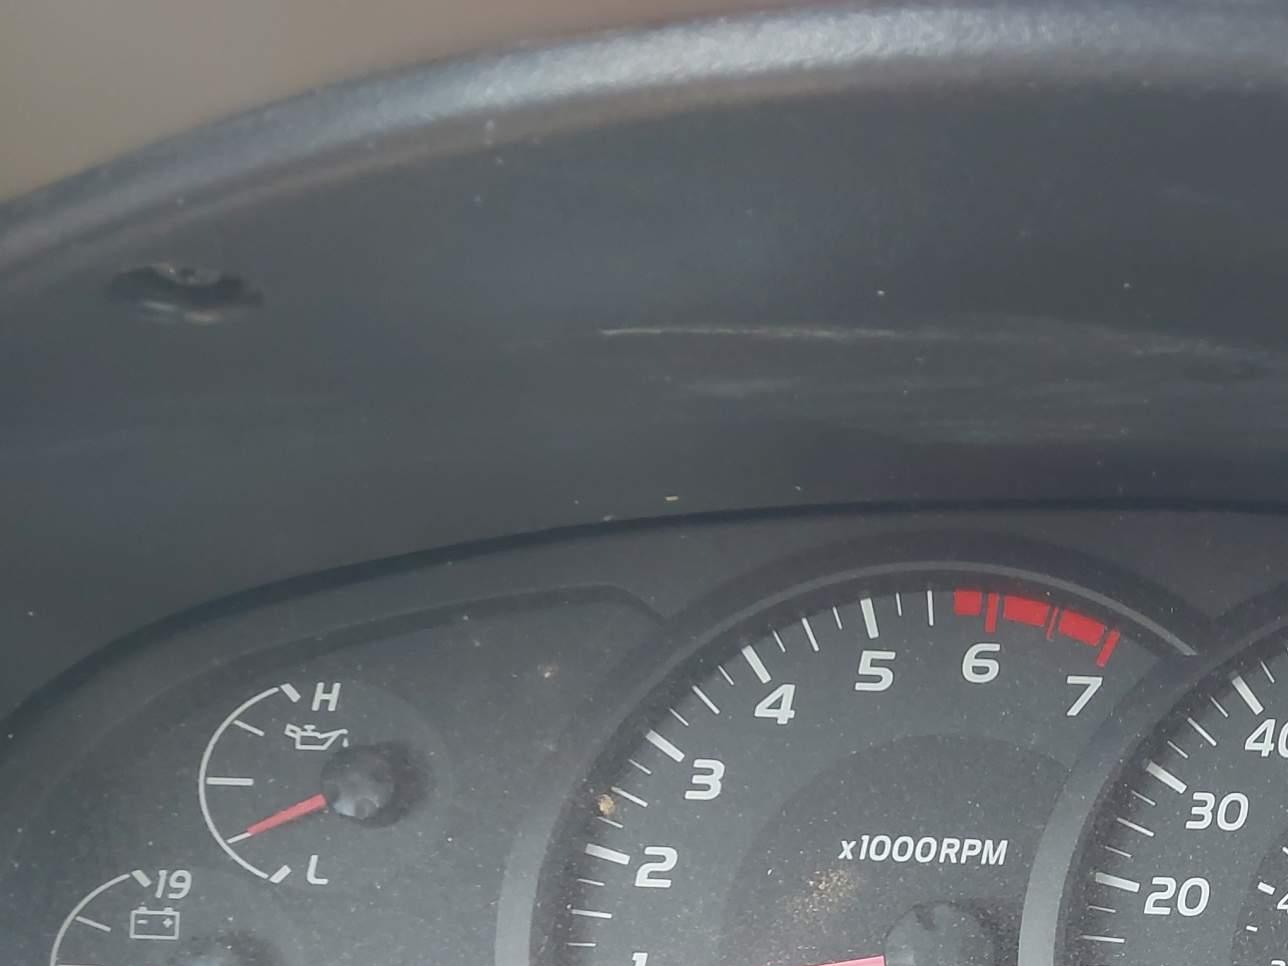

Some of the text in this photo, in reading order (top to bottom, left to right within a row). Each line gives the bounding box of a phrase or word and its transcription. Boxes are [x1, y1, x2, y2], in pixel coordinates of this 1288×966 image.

[855, 650, 895, 691] 5
[961, 643, 1000, 683] 6
[312, 682, 340, 711] H
[755, 684, 795, 724] 4
[1065, 677, 1103, 716] 7
[685, 760, 725, 800] 3
[1186, 792, 1248, 831] 30
[155, 870, 191, 899] 19
[306, 855, 328, 884] L
[634, 847, 677, 887] 2
[1143, 877, 1210, 916] 20
